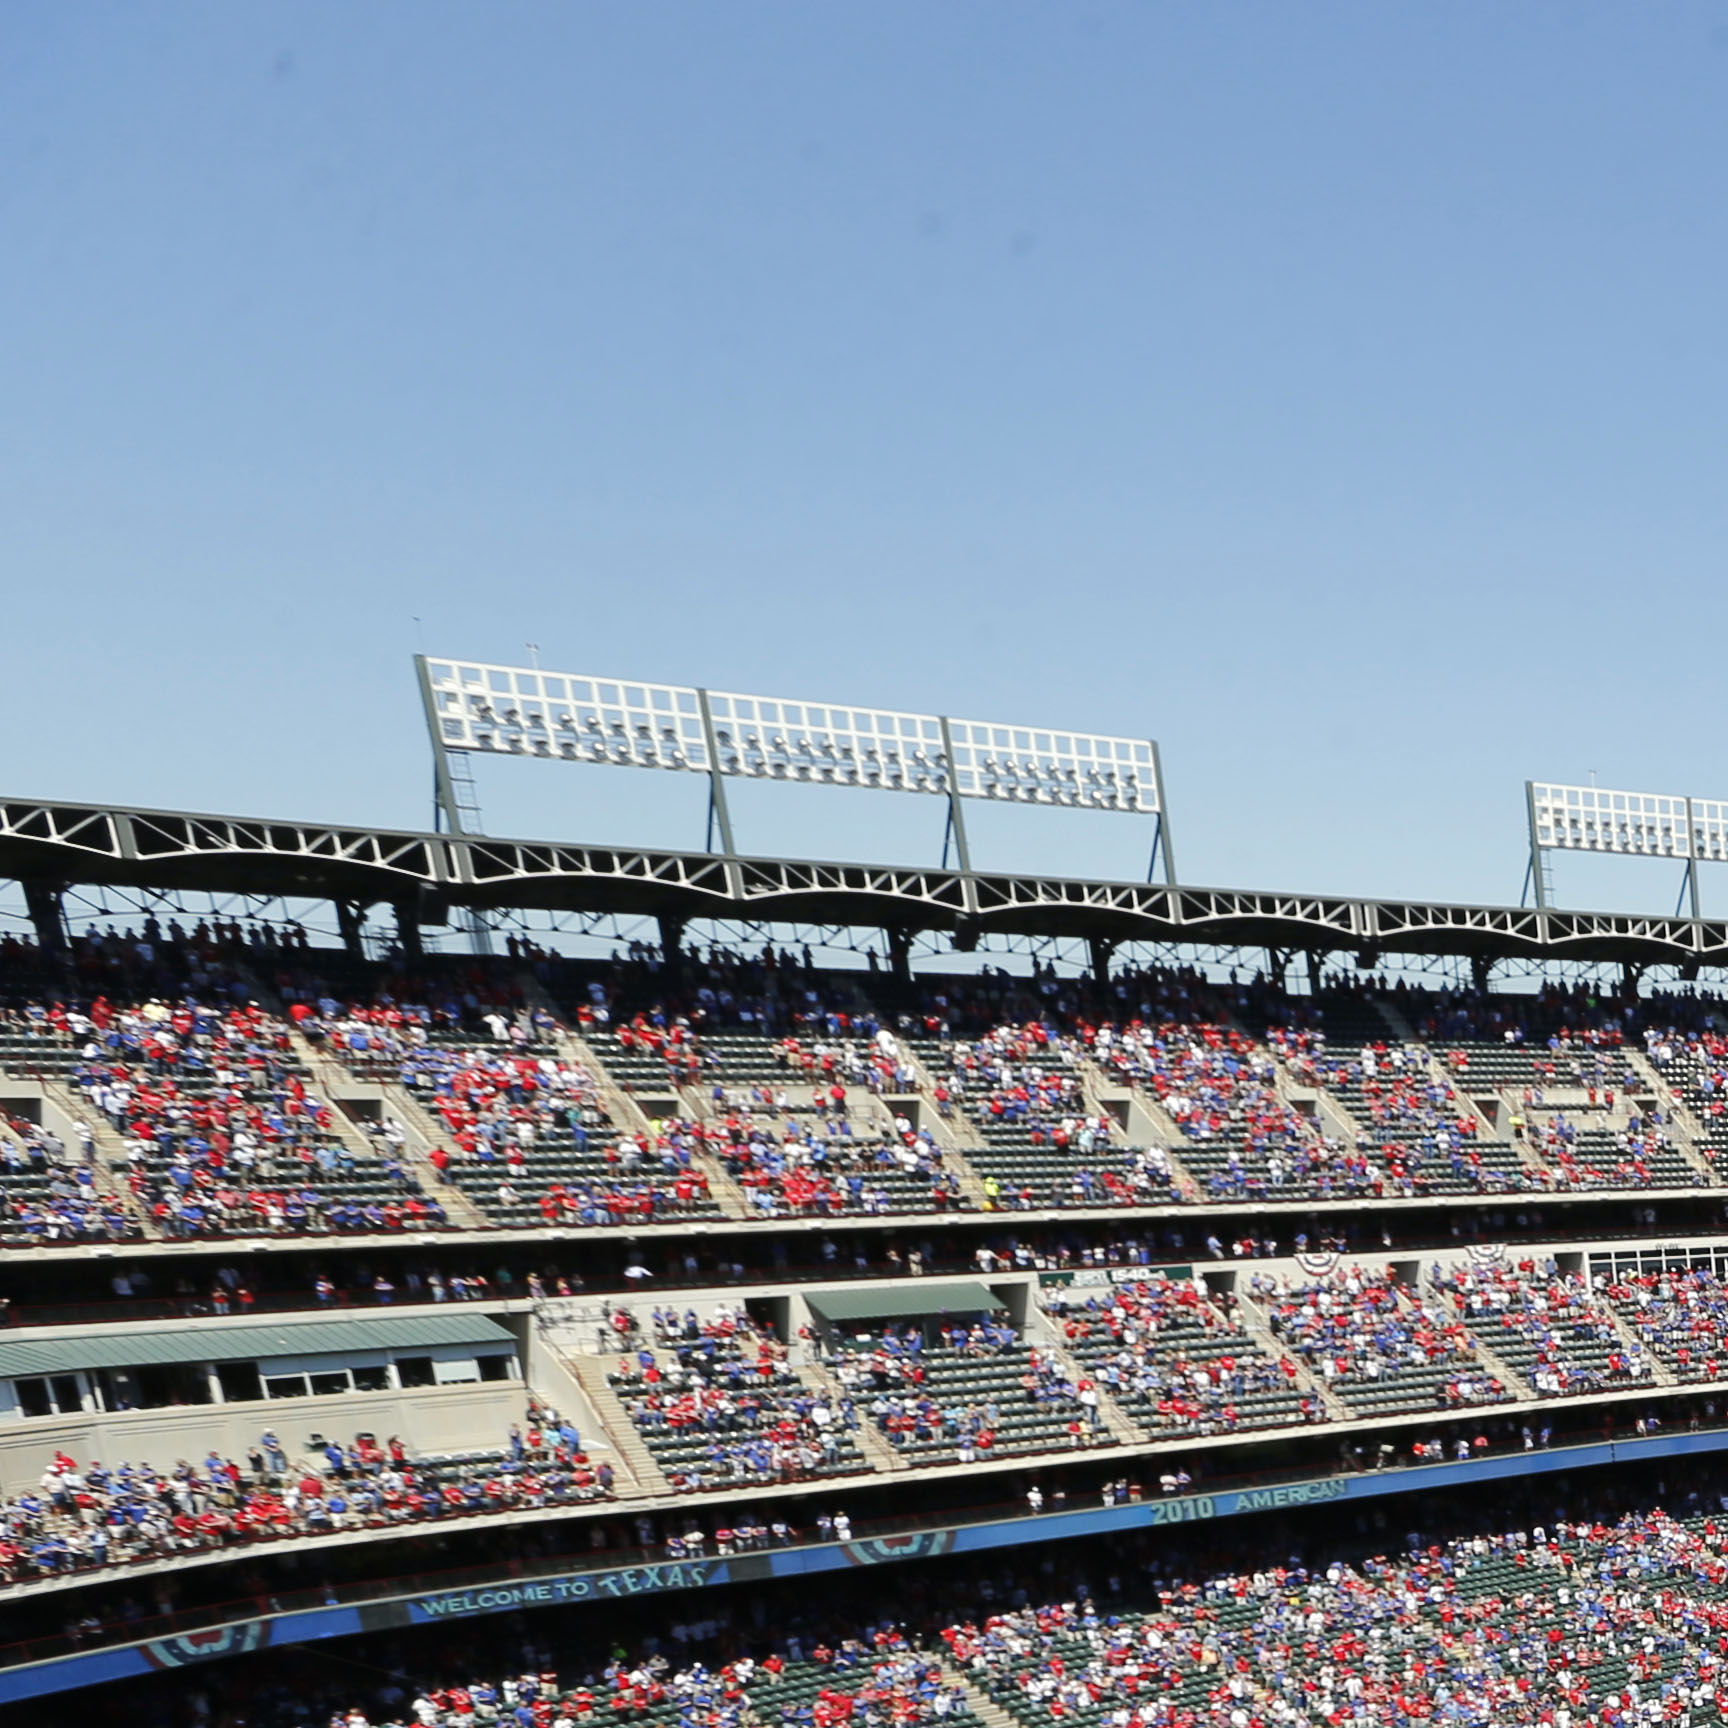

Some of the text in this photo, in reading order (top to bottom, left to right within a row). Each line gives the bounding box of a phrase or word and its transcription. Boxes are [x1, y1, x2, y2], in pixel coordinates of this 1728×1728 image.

[1150, 1480, 1348, 1526] 2010 AMERICAN
[422, 1566, 706, 1616] WELCOME TO TEXAS
